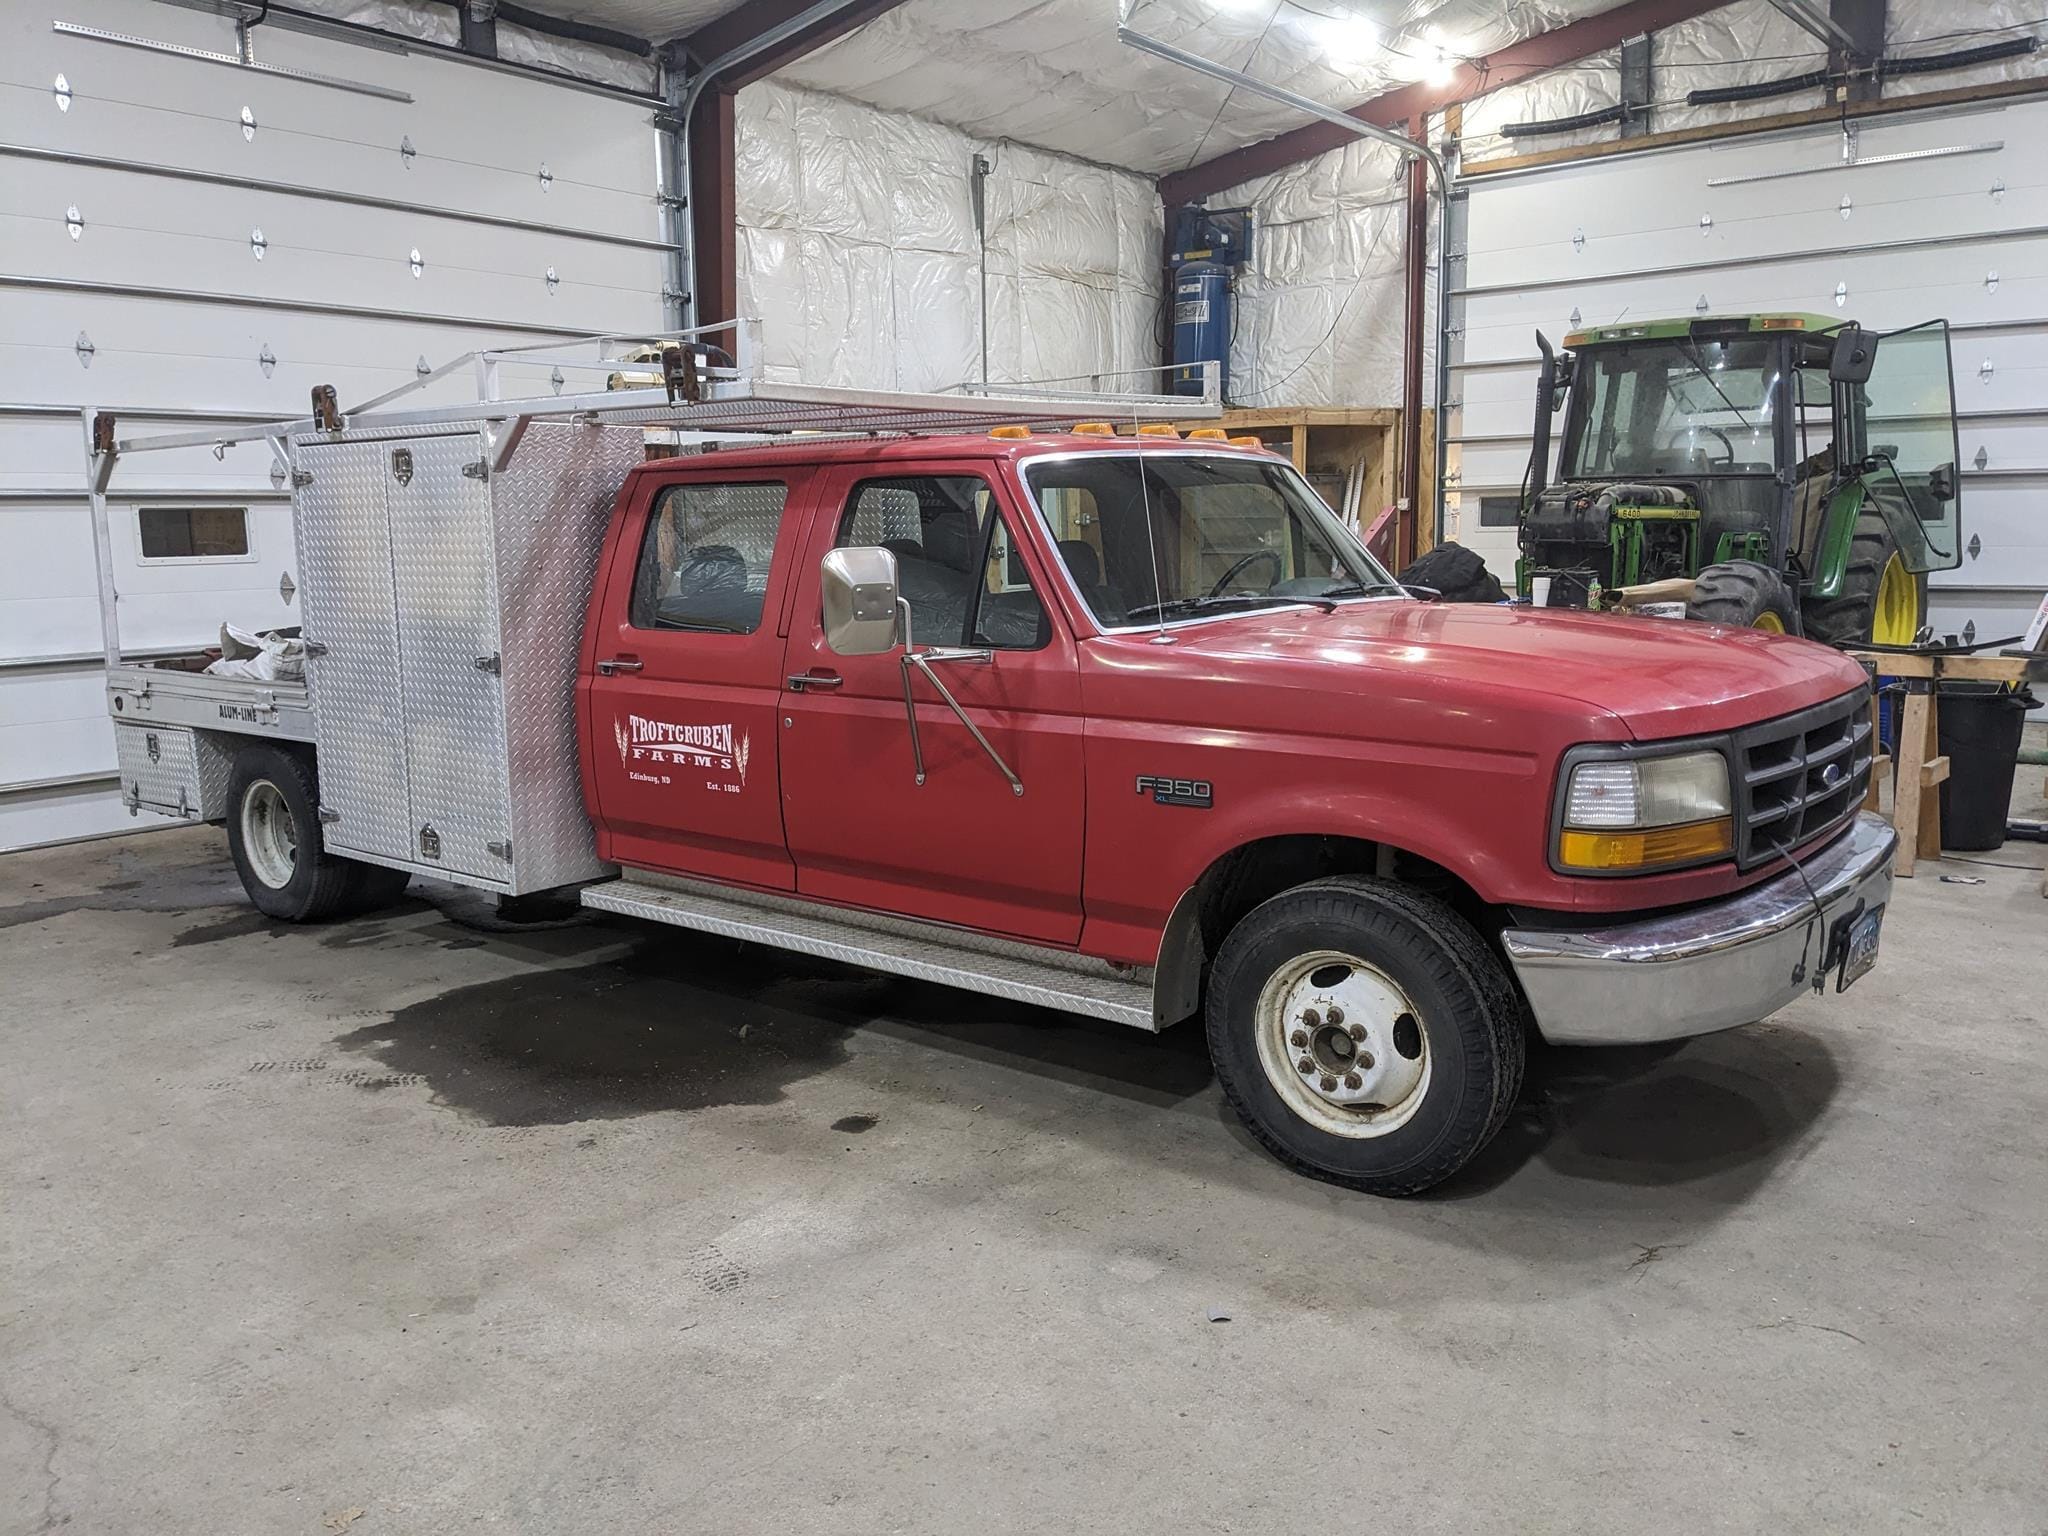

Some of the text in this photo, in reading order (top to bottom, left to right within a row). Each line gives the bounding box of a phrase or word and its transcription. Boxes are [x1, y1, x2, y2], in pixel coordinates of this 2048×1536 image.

[219, 704, 257, 722] ALUM-LINE
[629, 714, 732, 754] TROFTGRUBEN
[661, 775, 671, 784] ND
[707, 781, 721, 791] Est.
